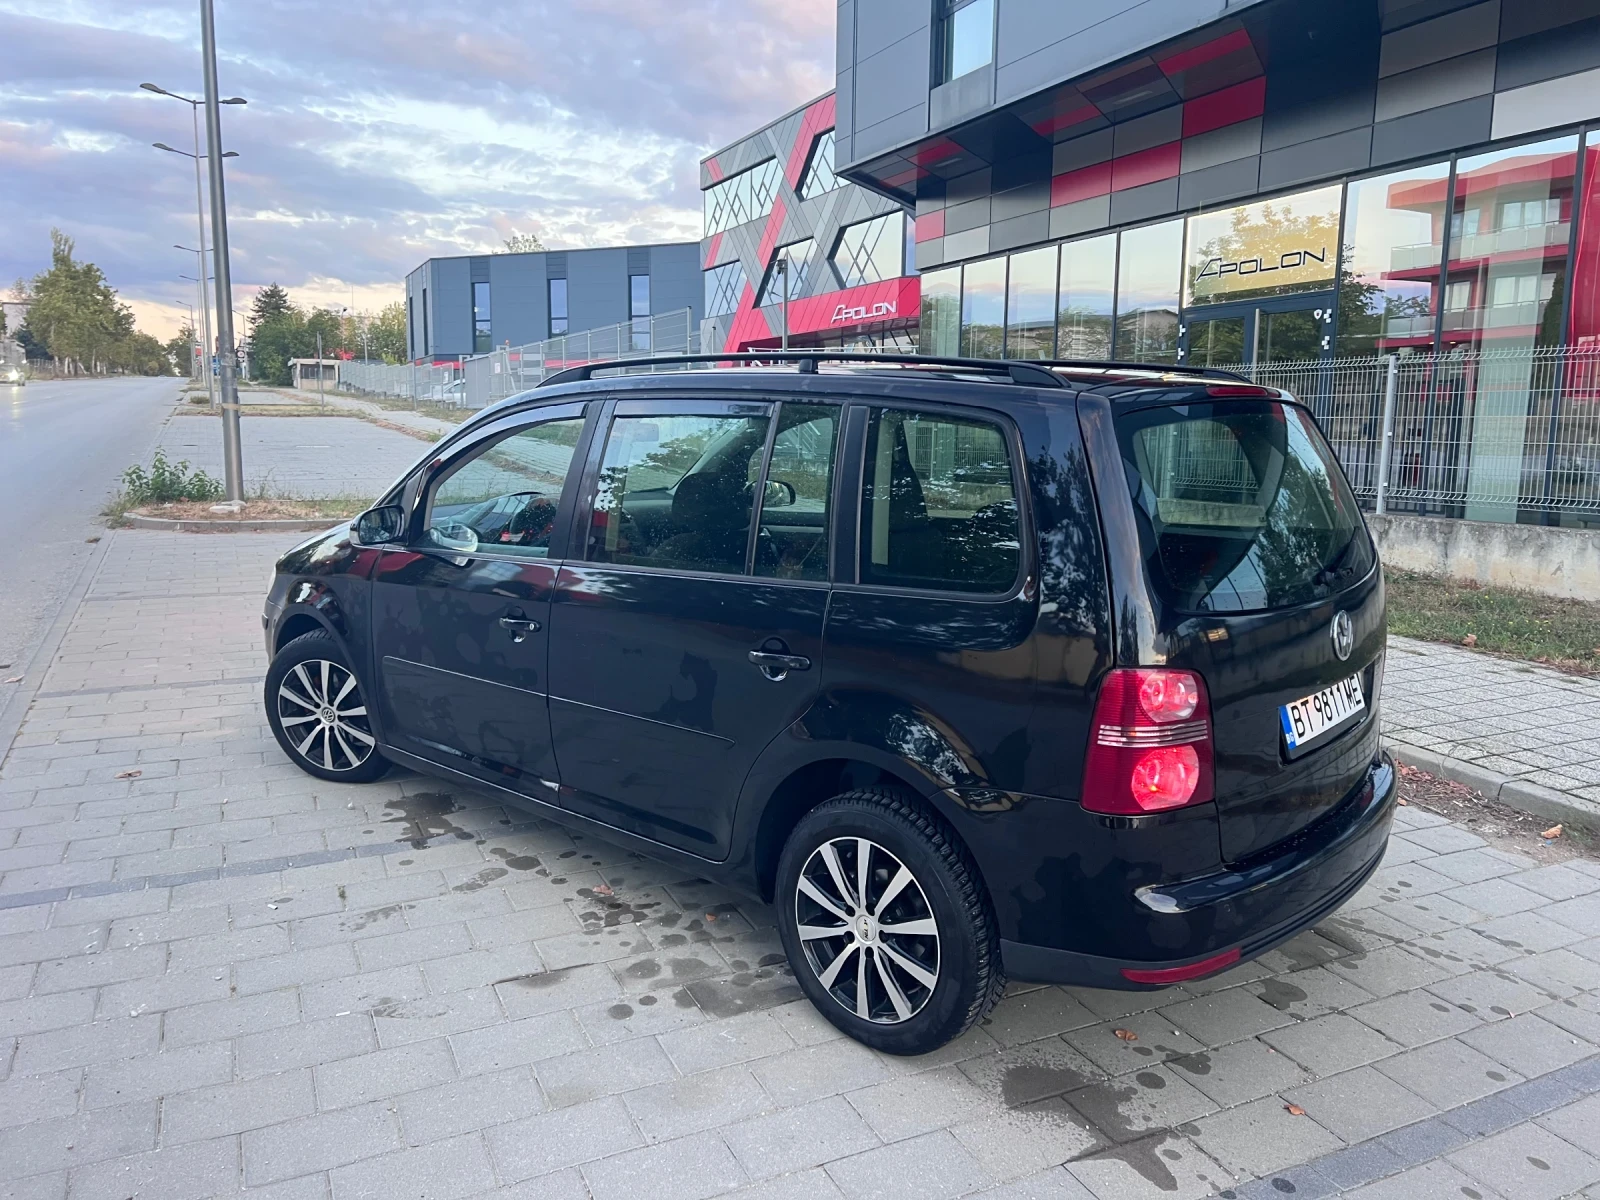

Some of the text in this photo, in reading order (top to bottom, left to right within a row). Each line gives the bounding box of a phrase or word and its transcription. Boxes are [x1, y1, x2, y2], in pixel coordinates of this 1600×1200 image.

[1196, 247, 1325, 281] APOLON
[831, 300, 897, 324] APOLON
[1291, 675, 1362, 738] BT 9811 ME
